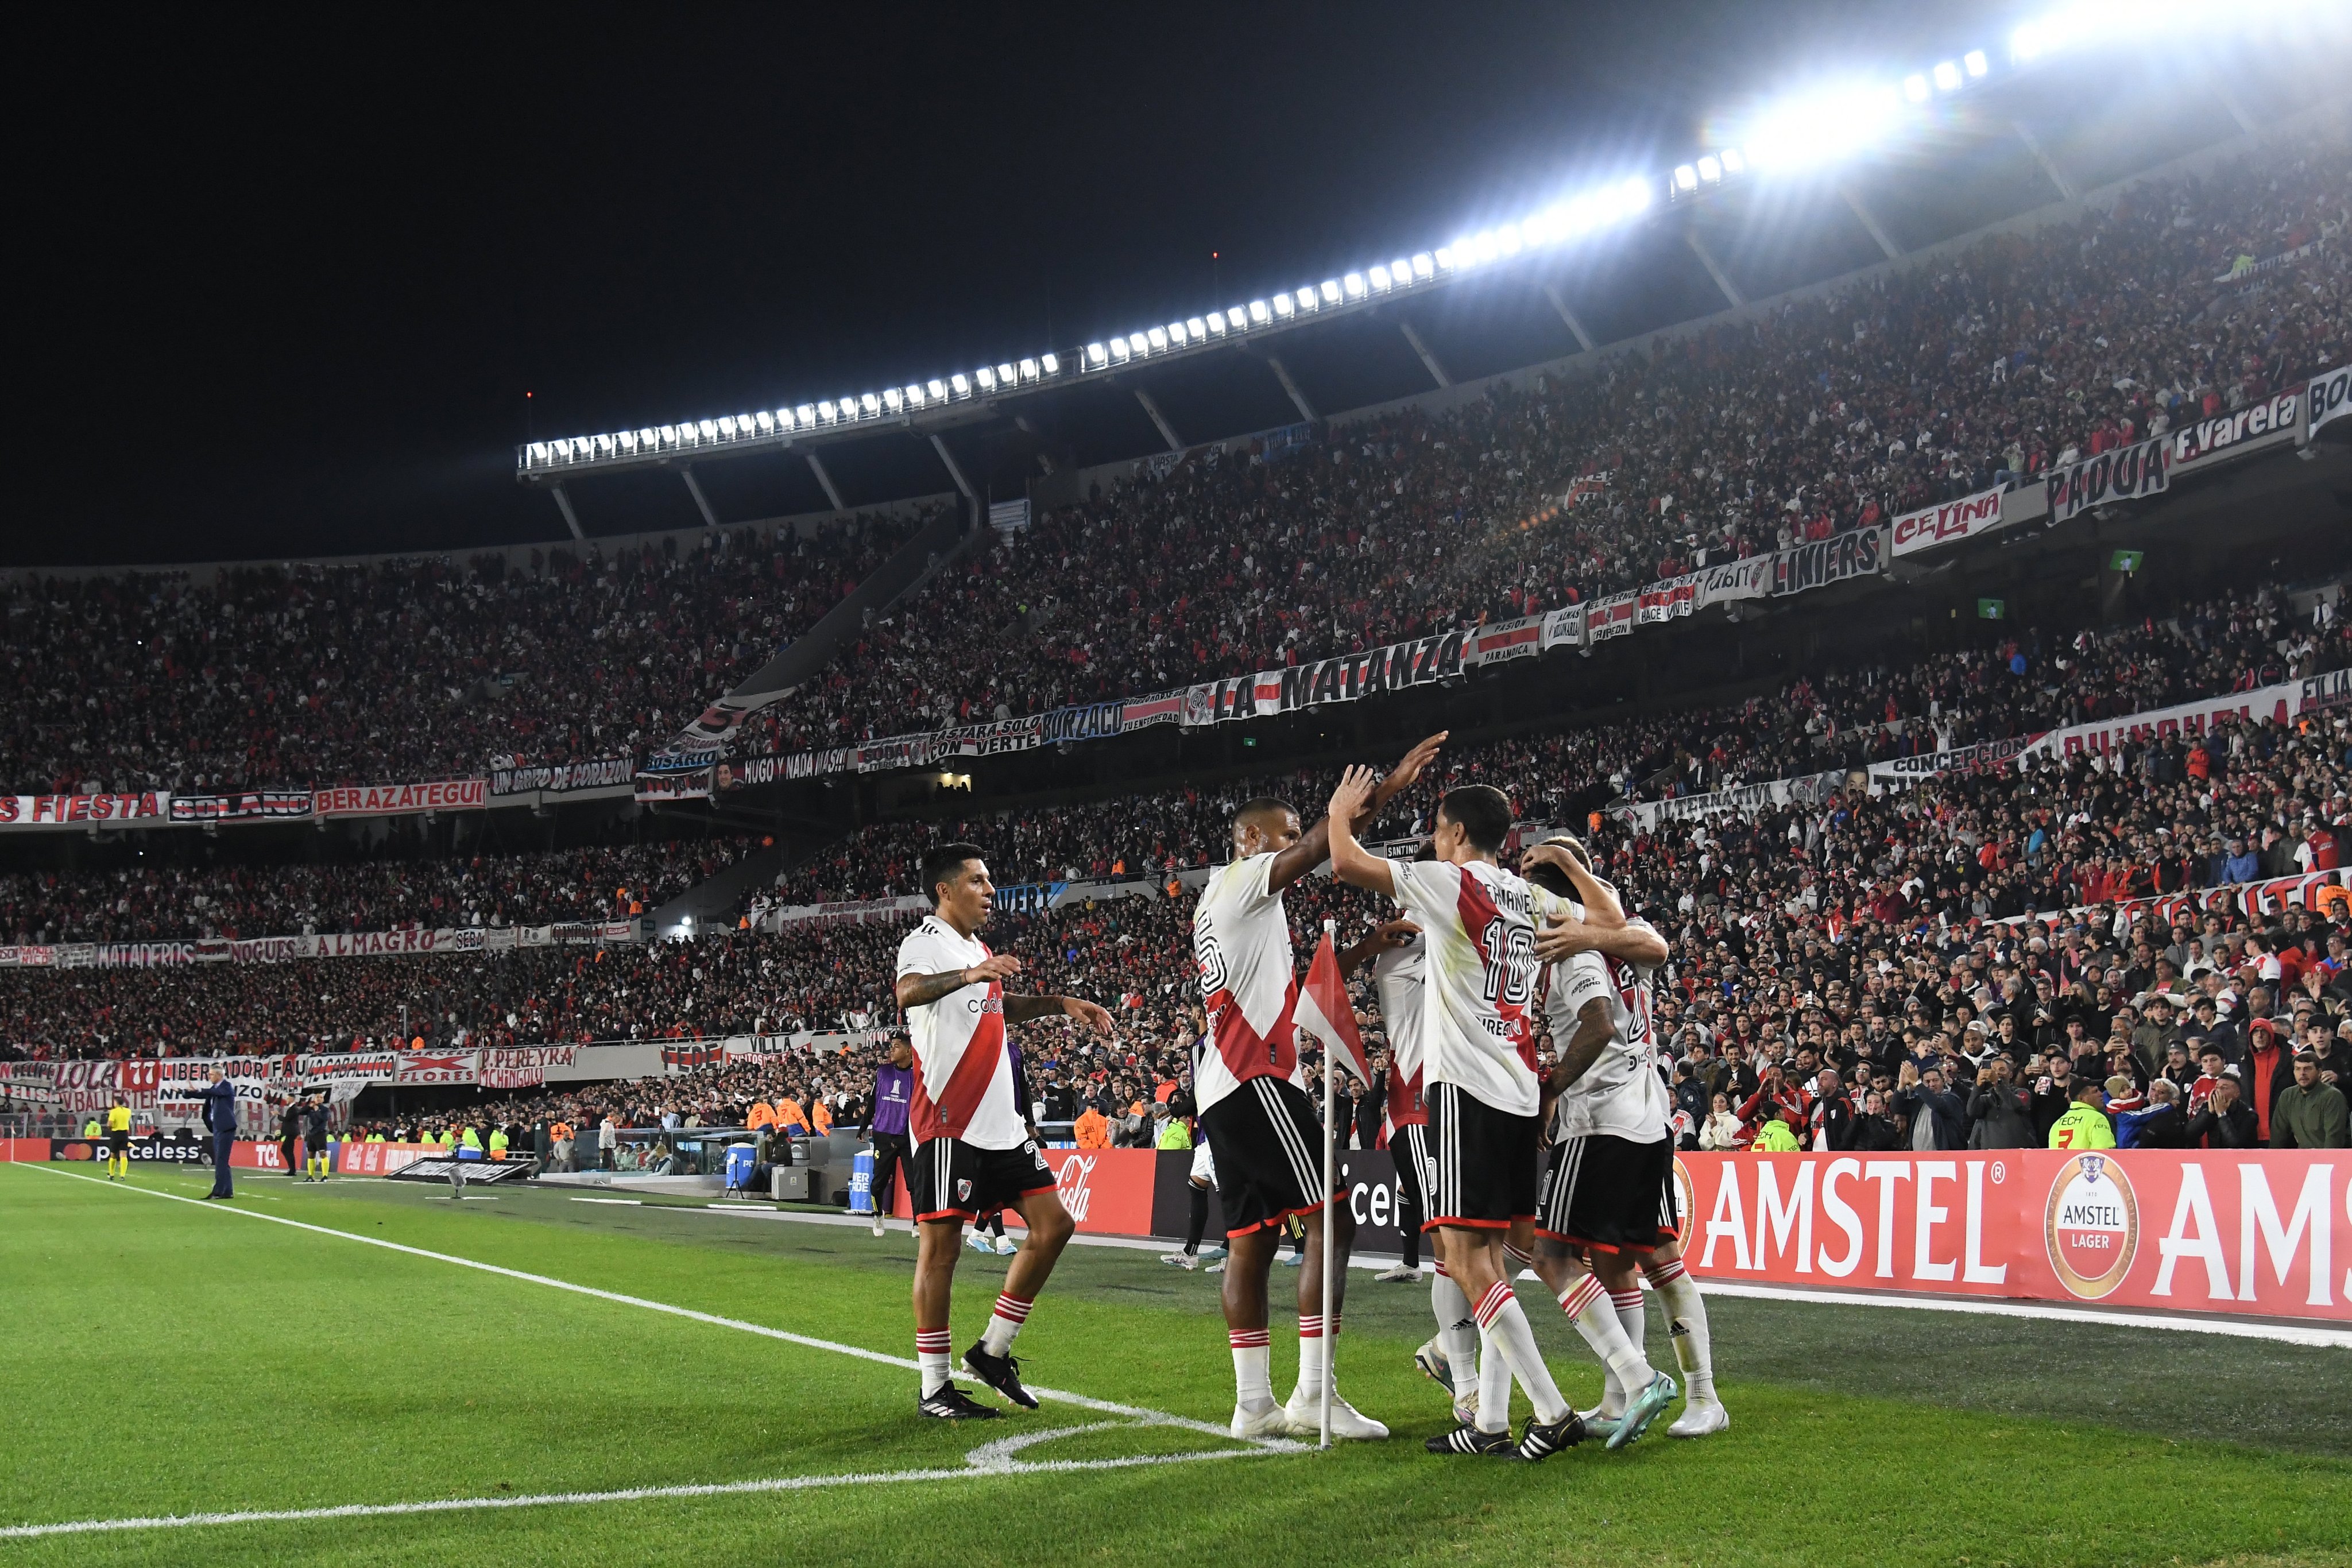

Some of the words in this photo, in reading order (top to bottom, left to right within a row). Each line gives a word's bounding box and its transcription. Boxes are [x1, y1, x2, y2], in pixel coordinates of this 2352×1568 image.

[2047, 440, 2166, 524] PADUA
[1773, 529, 1878, 595] LINIERS
[1643, 585, 1656, 594] EL
[1658, 577, 1683, 591] AMOR
[1589, 601, 1599, 610] EL
[1603, 591, 1636, 605] ETERNO
[1495, 619, 1527, 633] PASION
[1557, 609, 1579, 622] ALMAS
[1641, 608, 1662, 622] HACE
[1214, 675, 1255, 720] LA
[1281, 633, 1465, 710] MATANZA
[929, 723, 997, 745] BASTARA
[1001, 715, 1040, 733] SOLO
[1042, 702, 1123, 744] BURZACO
[1124, 722, 1133, 730] TU
[930, 740, 961, 760] CON
[977, 734, 1036, 755] VERTE
[1893, 737, 2028, 772] CONCEPCION
[493, 771, 512, 795] UN
[512, 768, 551, 792] GRITO
[551, 766, 570, 791] DE
[572, 759, 634, 787] CORAZON
[745, 757, 773, 784] HUGO
[776, 756, 784, 780] Y
[786, 753, 814, 780] NADA
[318, 780, 482, 812] BERAZATEGUI
[1655, 784, 1773, 823] ALTERNATIVA
[0, 796, 19, 822] S
[33, 793, 158, 822] FIESTA
[173, 796, 309, 819] SOLANO
[1388, 844, 1418, 857] SANTINO
[457, 931, 483, 948] SEBA
[98, 942, 195, 970] MATADEROS
[231, 940, 296, 963] NOGUES
[1481, 916, 1537, 1005] 10
[1572, 976, 1596, 997] ASSIST
[1579, 981, 1601, 993] CARD
[399, 1049, 477, 1057] MARCELO
[750, 1036, 791, 1054] VILLA
[273, 1060, 306, 1077] FAU
[323, 1054, 394, 1080] CABALLITO
[664, 1043, 718, 1073] FEDE
[13, 1062, 55, 1080] FELIPE
[56, 1062, 121, 1090] LOLA
[129, 1062, 156, 1085] 77
[399, 1071, 474, 1082] FLORES
[10, 1085, 62, 1104] ELISA
[2059, 1116, 2083, 1126] TECH
[96, 1140, 200, 1162] pceless
[257, 1145, 280, 1166] TCL
[1700, 1157, 2006, 1284] AMSTEL
[2064, 1205, 2119, 1226] AMSTEL
[2072, 1234, 2109, 1249] LAGER
